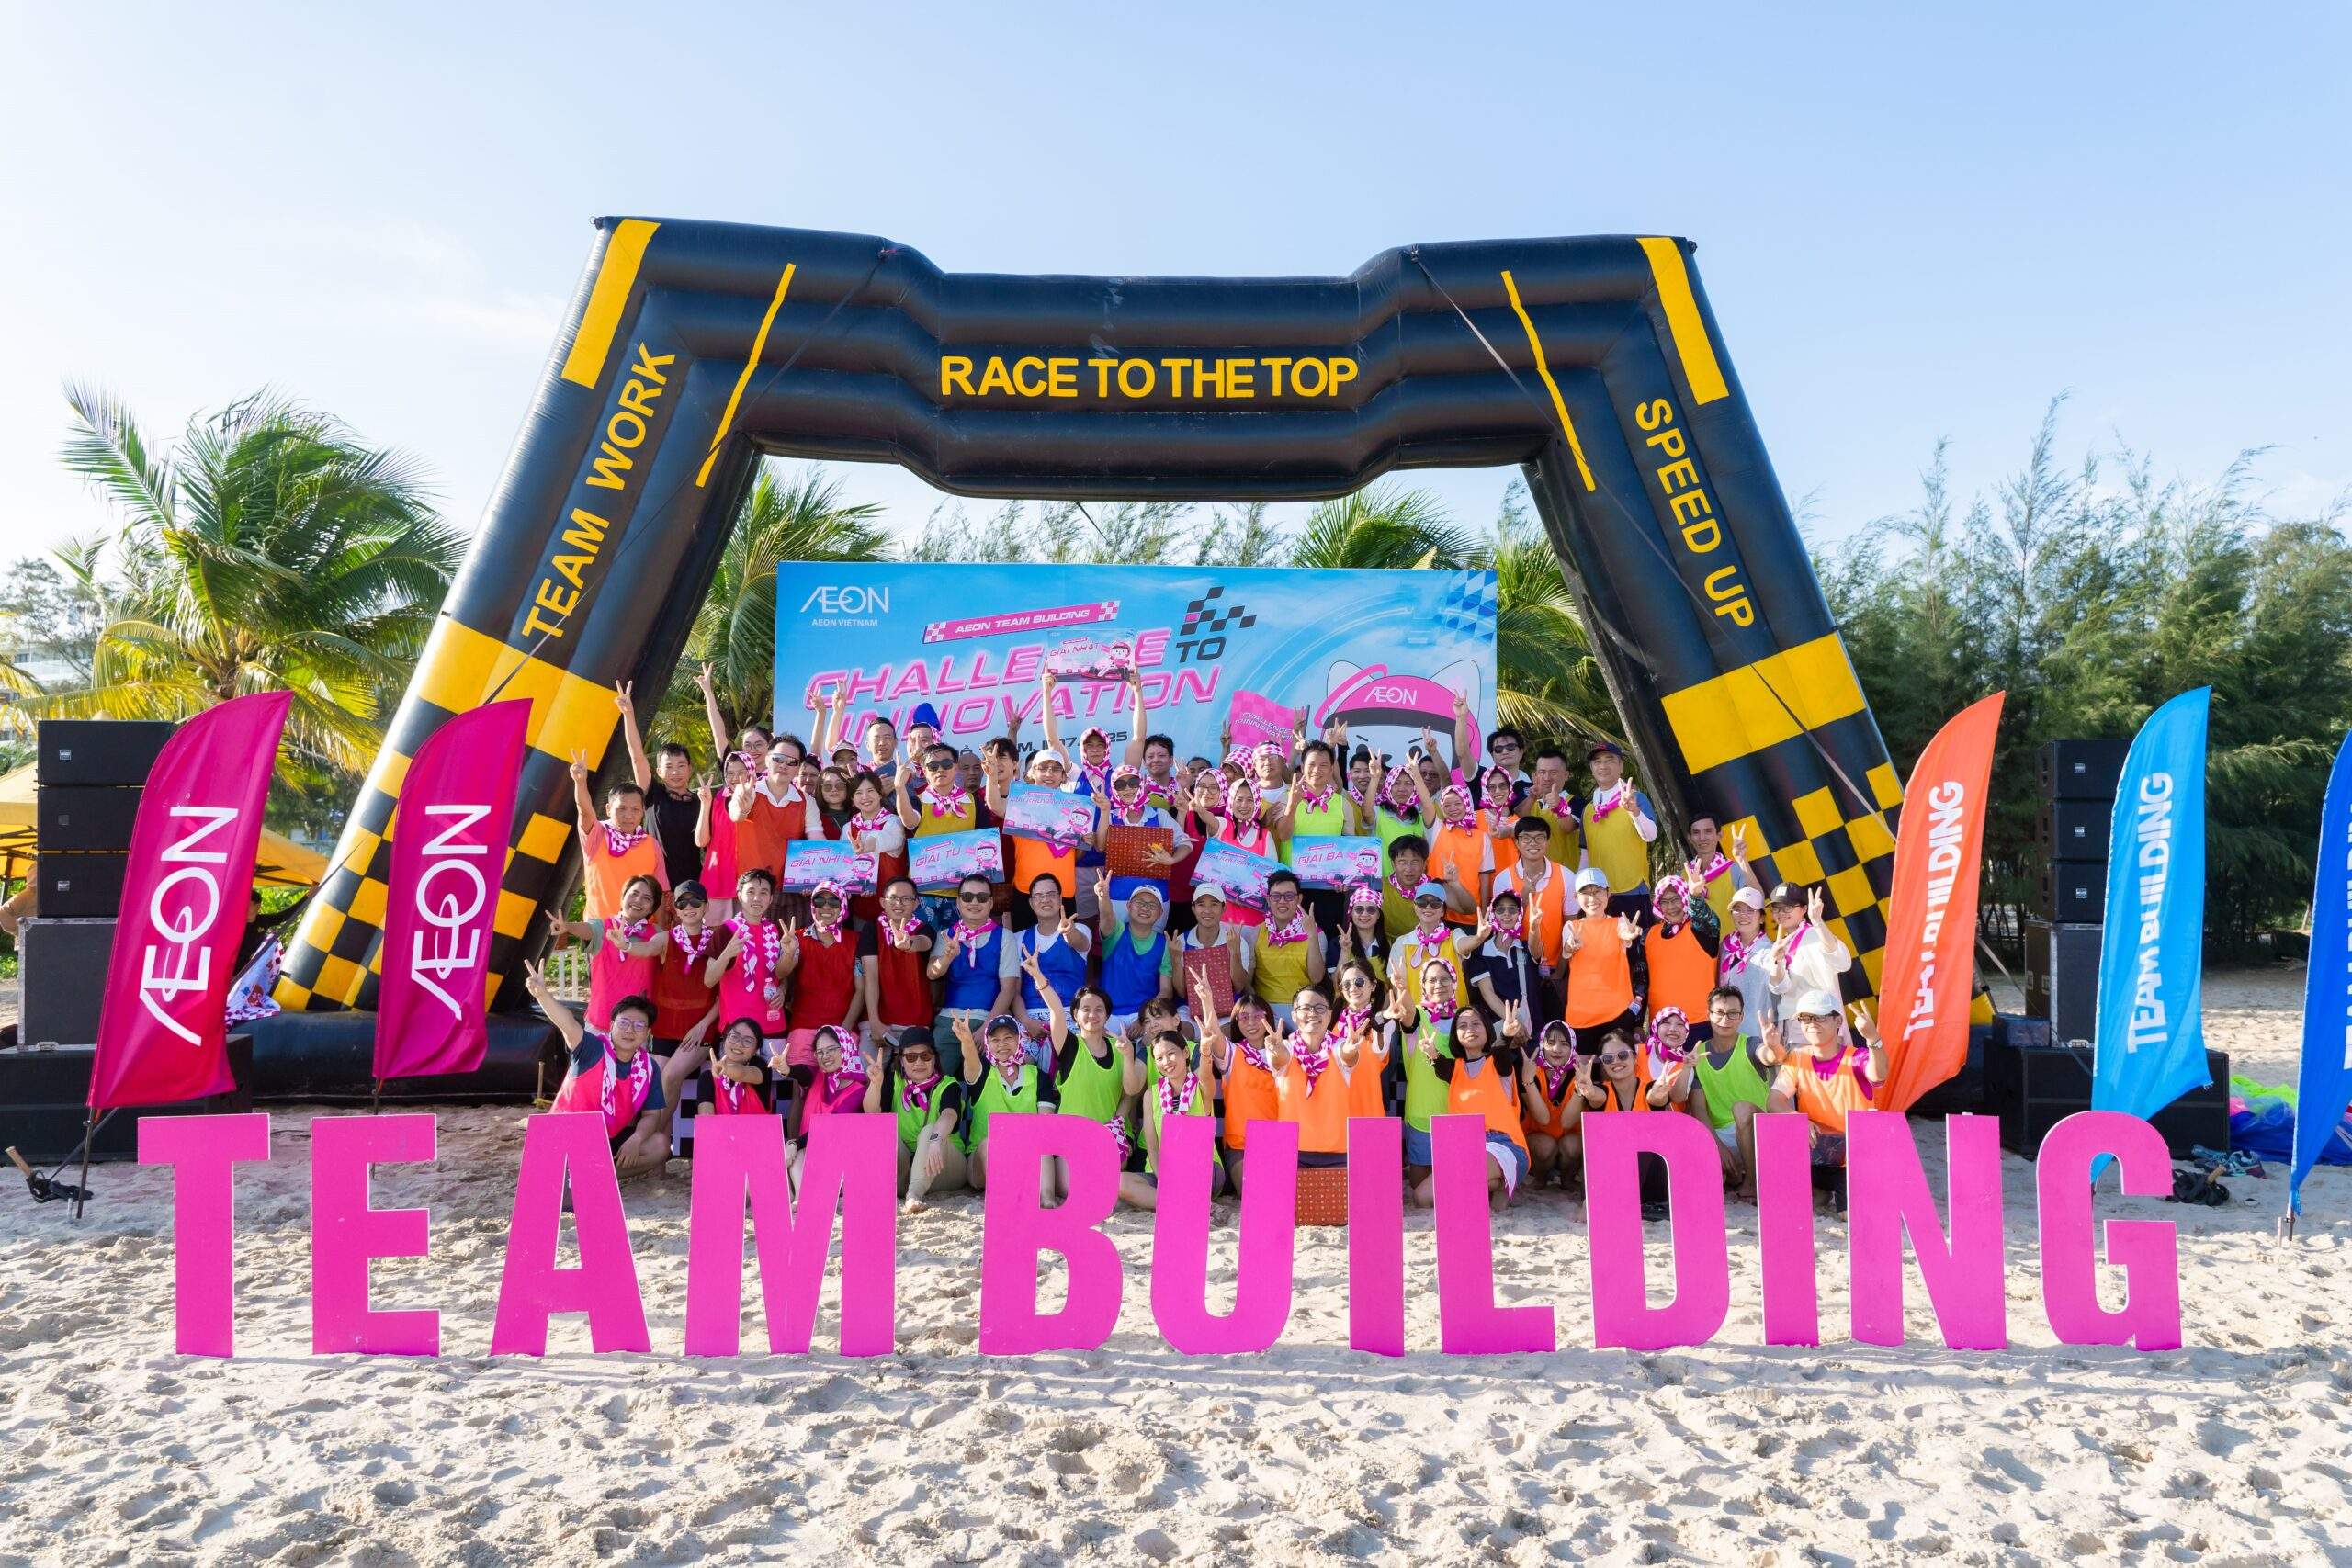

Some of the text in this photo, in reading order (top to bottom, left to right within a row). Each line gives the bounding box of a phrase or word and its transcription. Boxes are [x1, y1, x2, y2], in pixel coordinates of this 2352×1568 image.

[940, 355, 1359, 399] RACE TO THE TOP
[522, 345, 676, 638] TEAM WORK
[1634, 399, 1755, 627] SPEED UP
[812, 619, 878, 627] AEON VIETNAM
[955, 609, 1090, 634] AEON TEAM BUILDING
[1175, 637, 1227, 663] TO
[804, 626, 1172, 711] CHALLEE
[137, 1110, 2183, 1359] TEAM BUILDING
